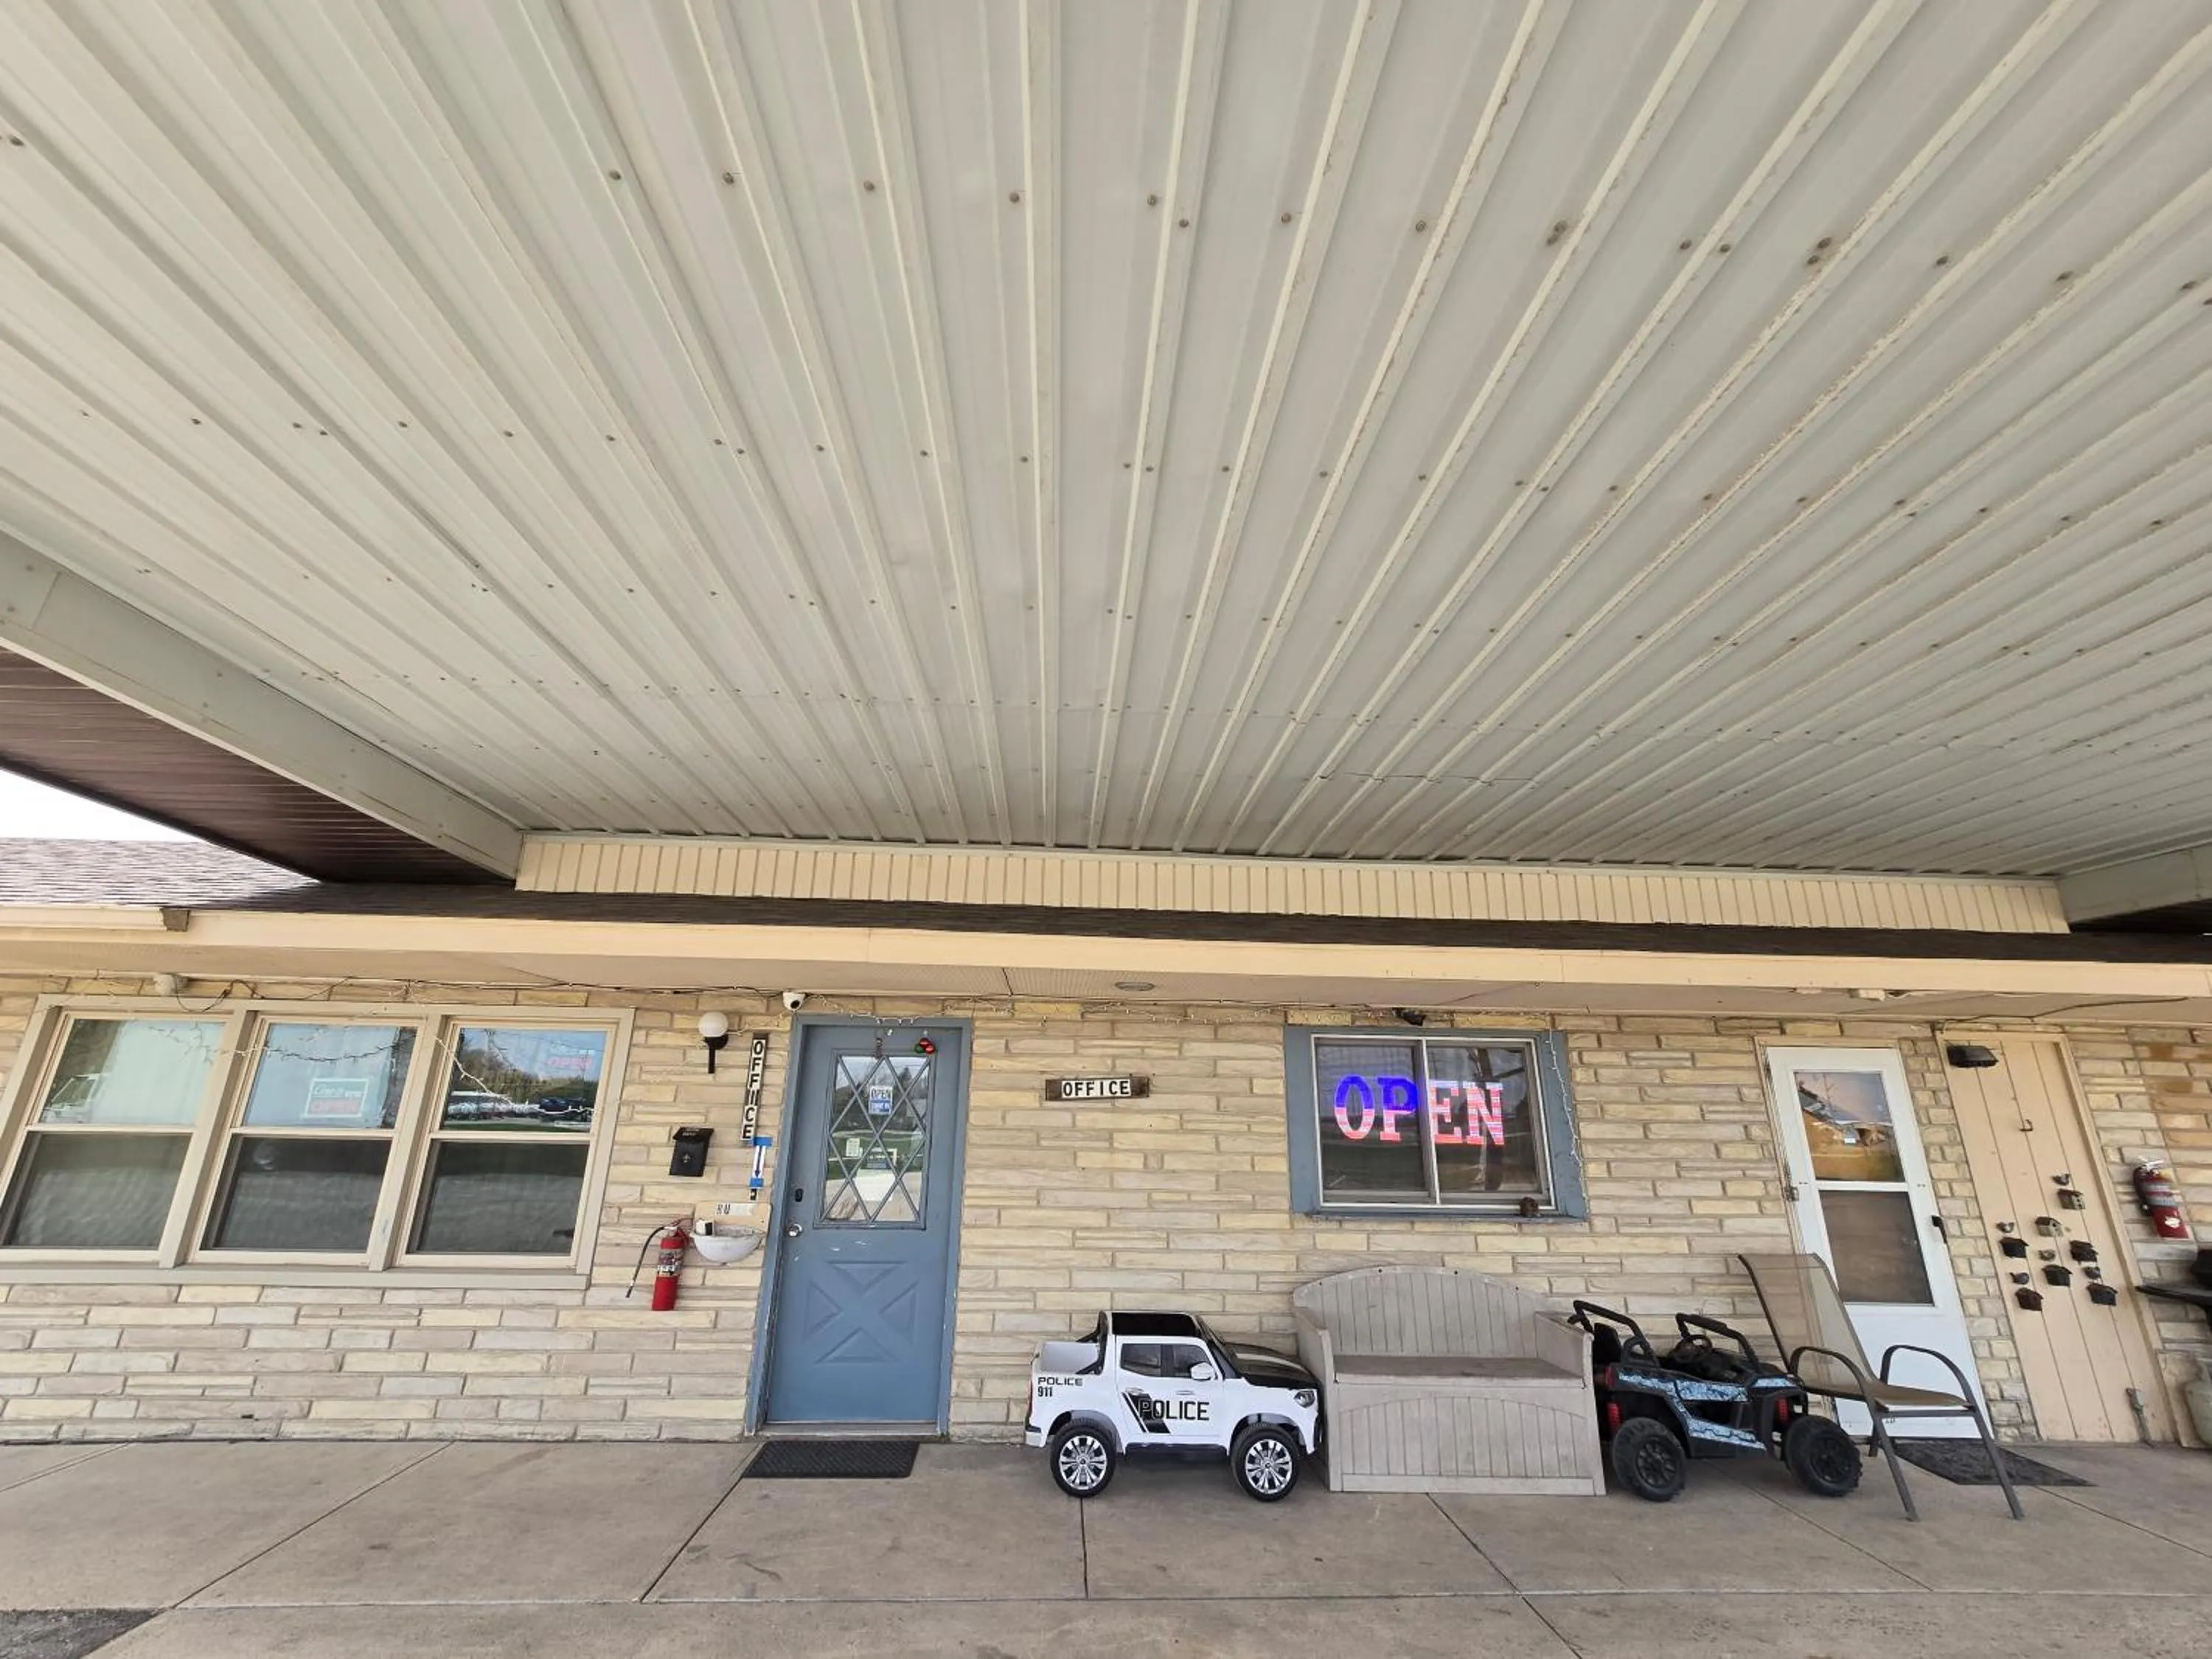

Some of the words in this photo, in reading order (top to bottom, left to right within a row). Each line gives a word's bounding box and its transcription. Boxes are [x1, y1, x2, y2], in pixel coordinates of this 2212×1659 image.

[742, 1040, 763, 1139] OFFICE
[1062, 1080, 1130, 1096] OFFICE
[1334, 1074, 1505, 1146] OPEN
[1038, 1377, 1082, 1387] POLICE
[1038, 1386, 1053, 1397] 911
[1139, 1399, 1210, 1421] POLICE
